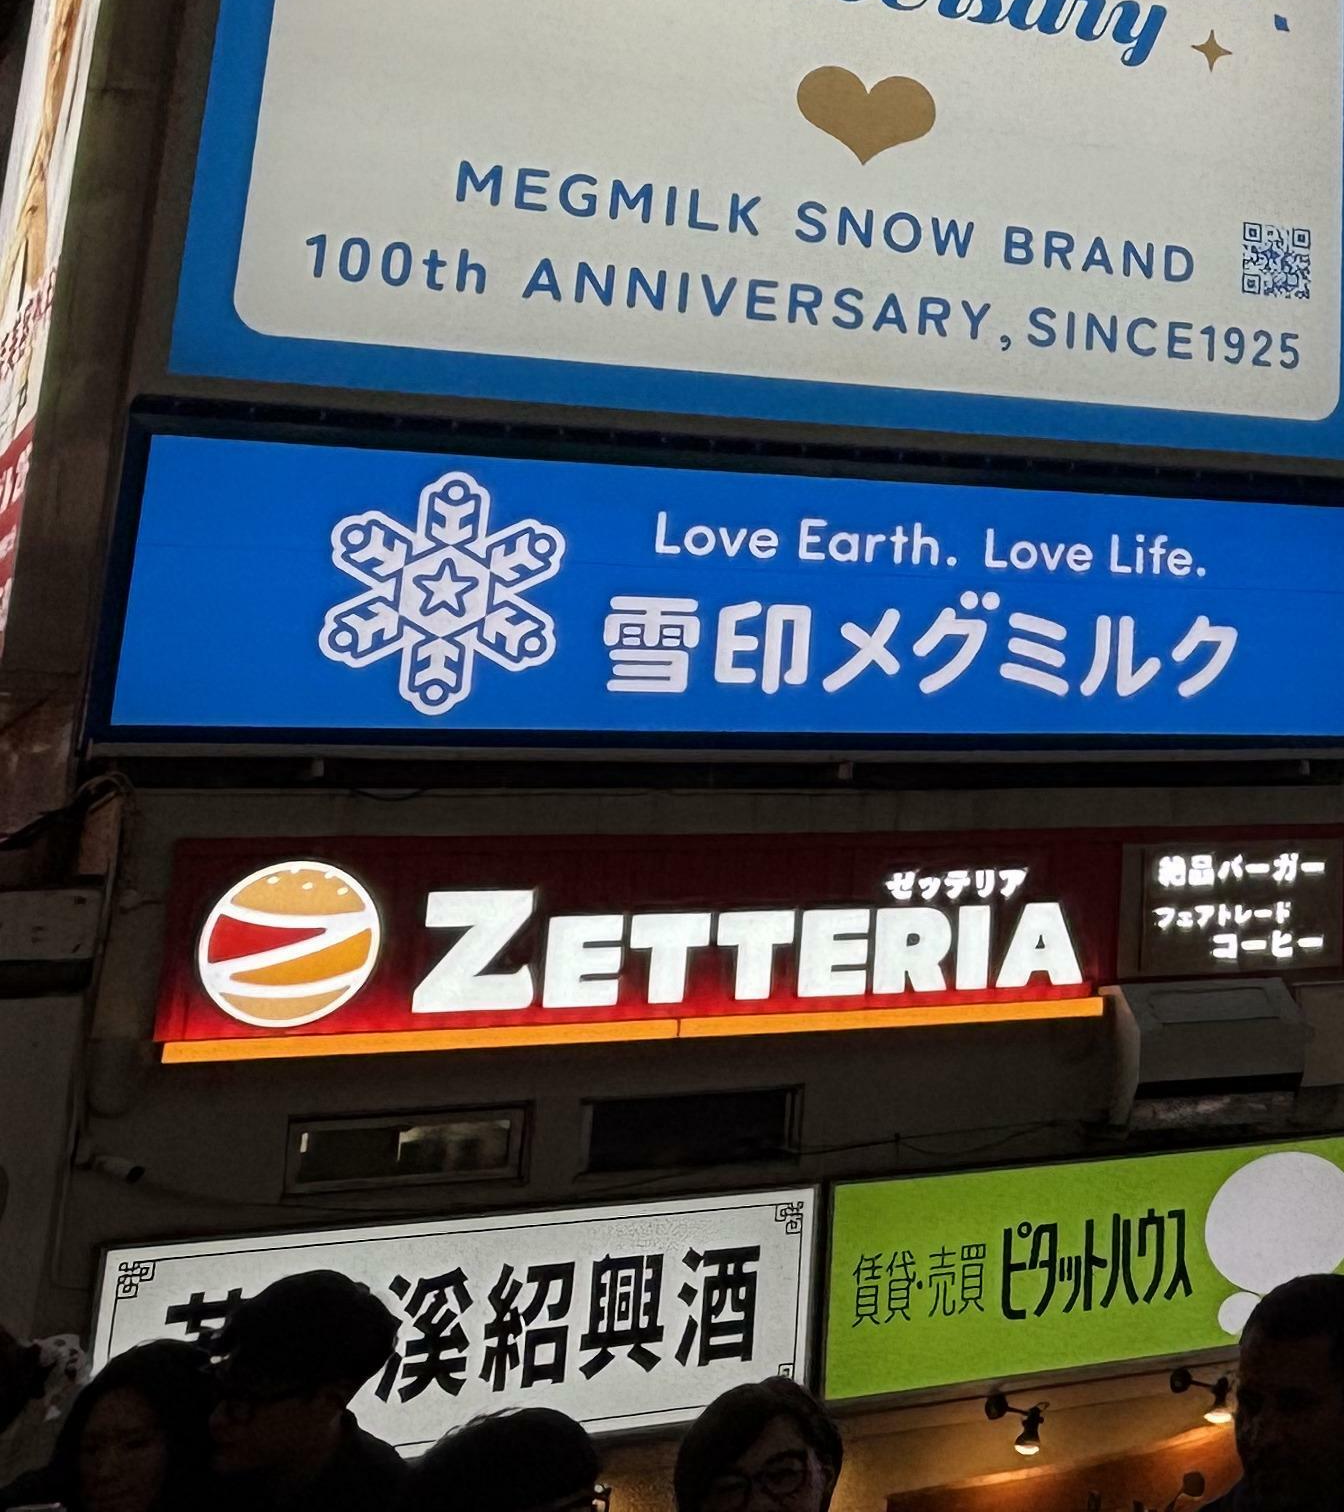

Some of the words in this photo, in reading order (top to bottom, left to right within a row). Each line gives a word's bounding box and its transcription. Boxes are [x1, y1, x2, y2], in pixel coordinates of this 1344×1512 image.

[455, 160, 763, 238] MEGMILK
[796, 201, 976, 260] SNOW
[1003, 226, 1195, 285] BRAND
[304, 233, 487, 297] 100th
[655, 511, 778, 561] Love
[798, 518, 958, 568] Earth.
[985, 527, 1094, 576] Love
[1109, 534, 1208, 580] Life.
[602, 591, 1240, 699] 雪印メグミルク
[886, 866, 1030, 901] ゼッテリア
[1152, 901, 1292, 927] フェアトレード
[411, 886, 1087, 1015] ZETTERIA
[1211, 929, 1324, 960] コーヒー
[1001, 1208, 1194, 1321] ピタットハウス
